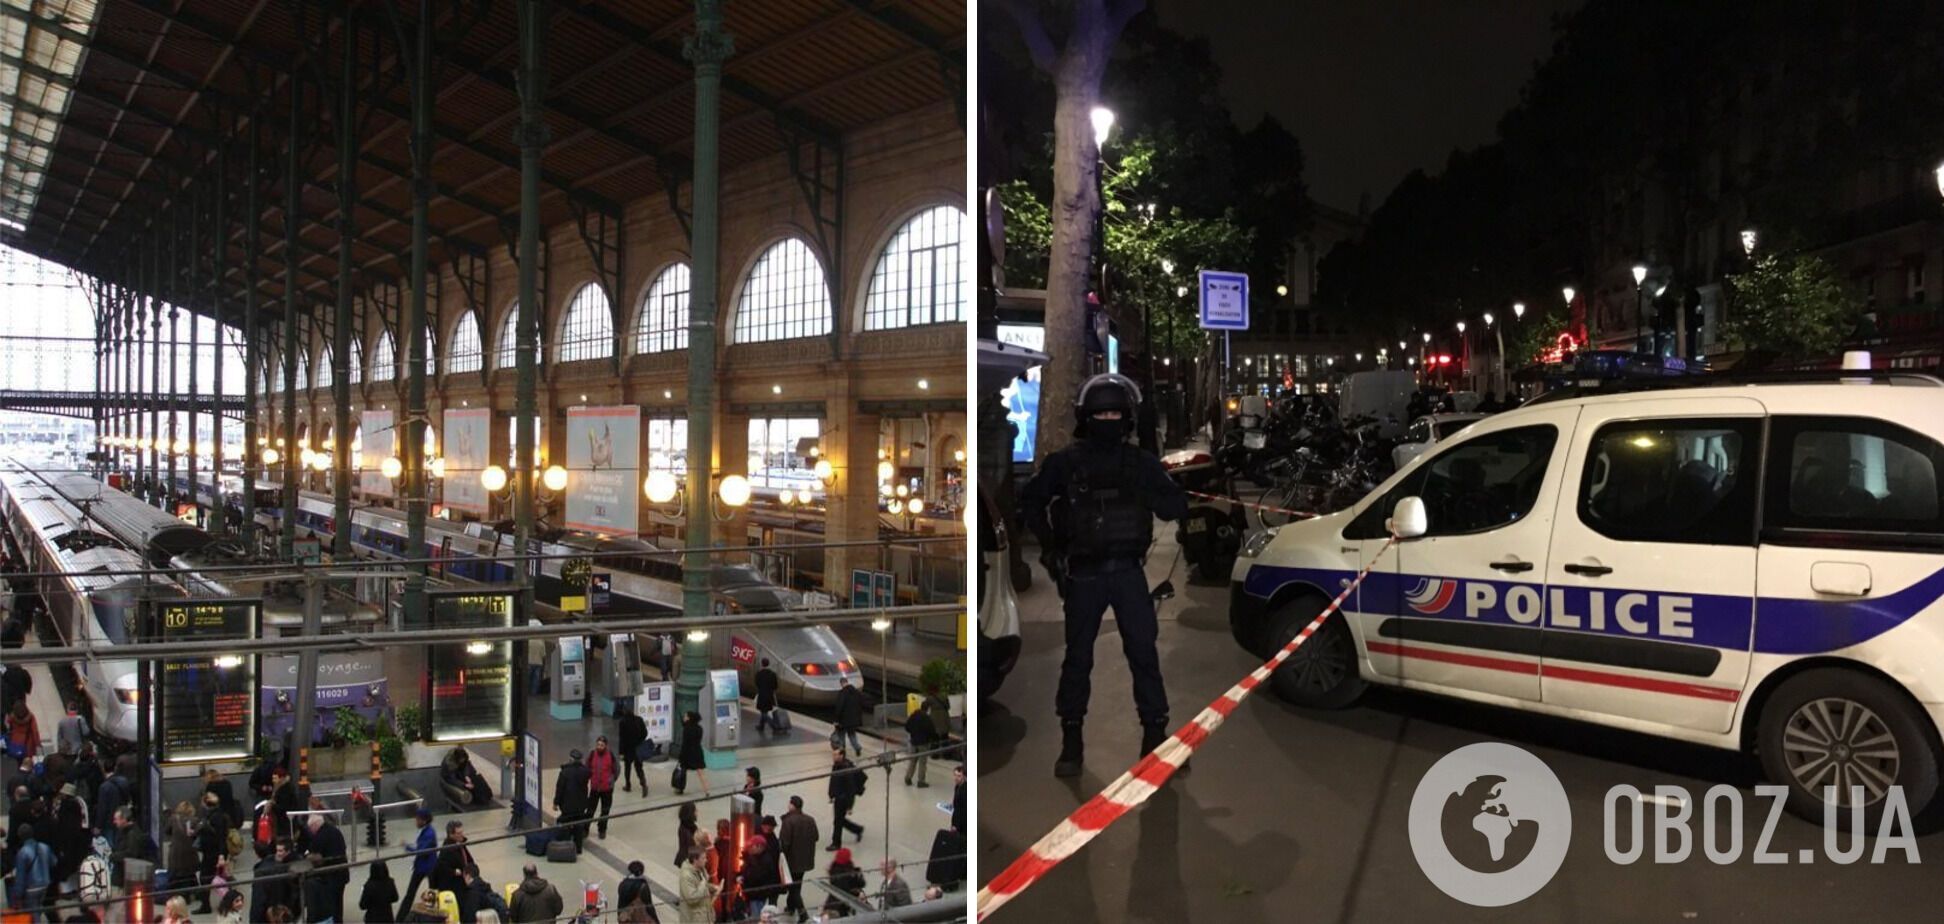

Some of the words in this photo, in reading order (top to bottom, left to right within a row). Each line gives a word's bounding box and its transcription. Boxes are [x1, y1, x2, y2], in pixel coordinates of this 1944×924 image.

[1465, 581, 1694, 638] POLICE
[168, 613, 186, 626] 10
[732, 645, 754, 660] SNCF
